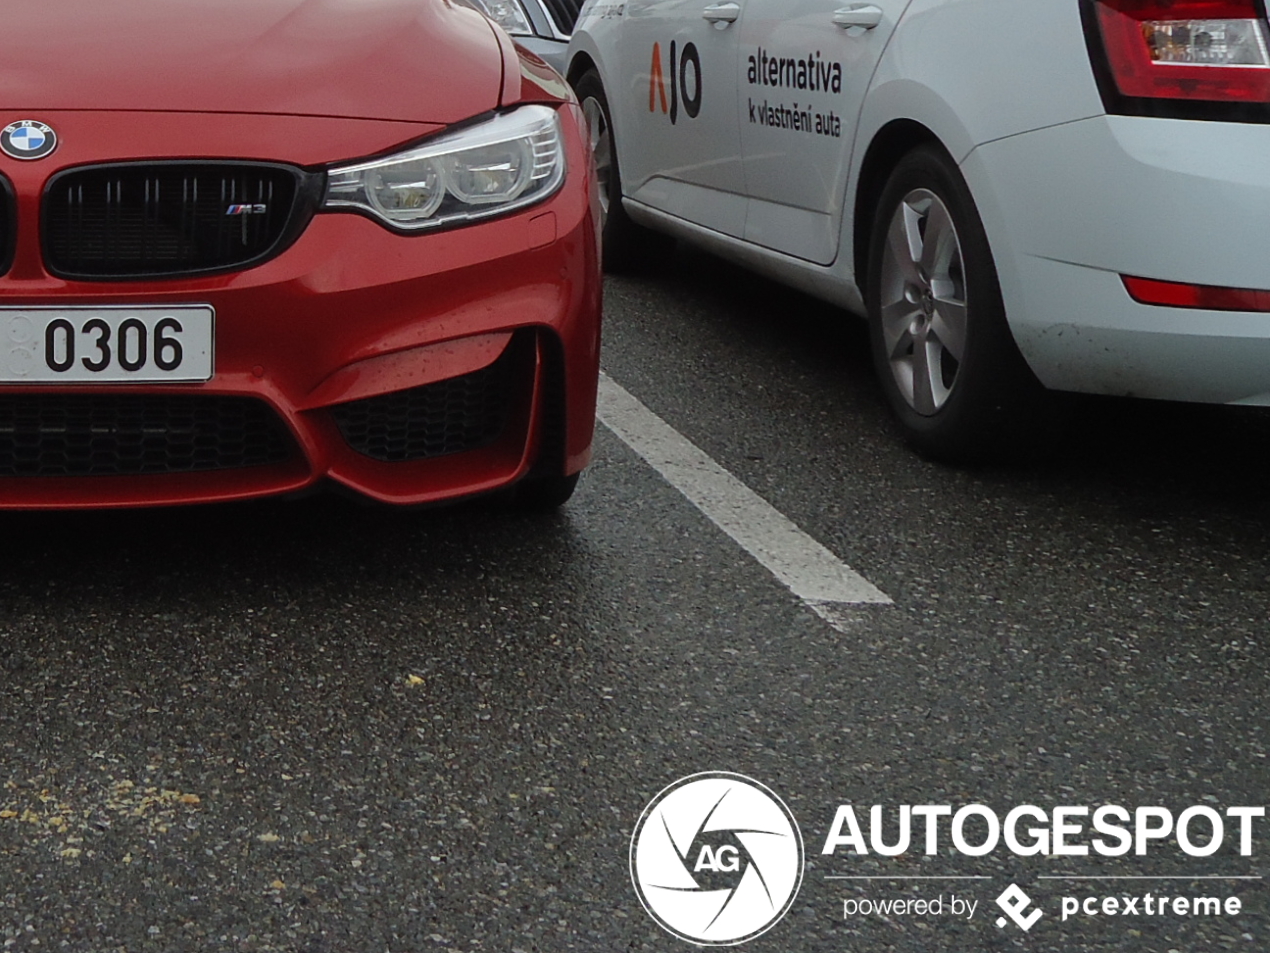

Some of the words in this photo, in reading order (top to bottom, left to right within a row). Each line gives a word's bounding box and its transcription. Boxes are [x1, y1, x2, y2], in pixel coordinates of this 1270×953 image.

[649, 39, 702, 125] AJO
[747, 46, 842, 94] alternativa
[4, 120, 51, 133] BMW
[749, 98, 756, 123] k
[758, 100, 813, 133] vlastnění
[815, 111, 841, 137] auta
[236, 204, 266, 214] M3
[45, 318, 183, 372] 0306
